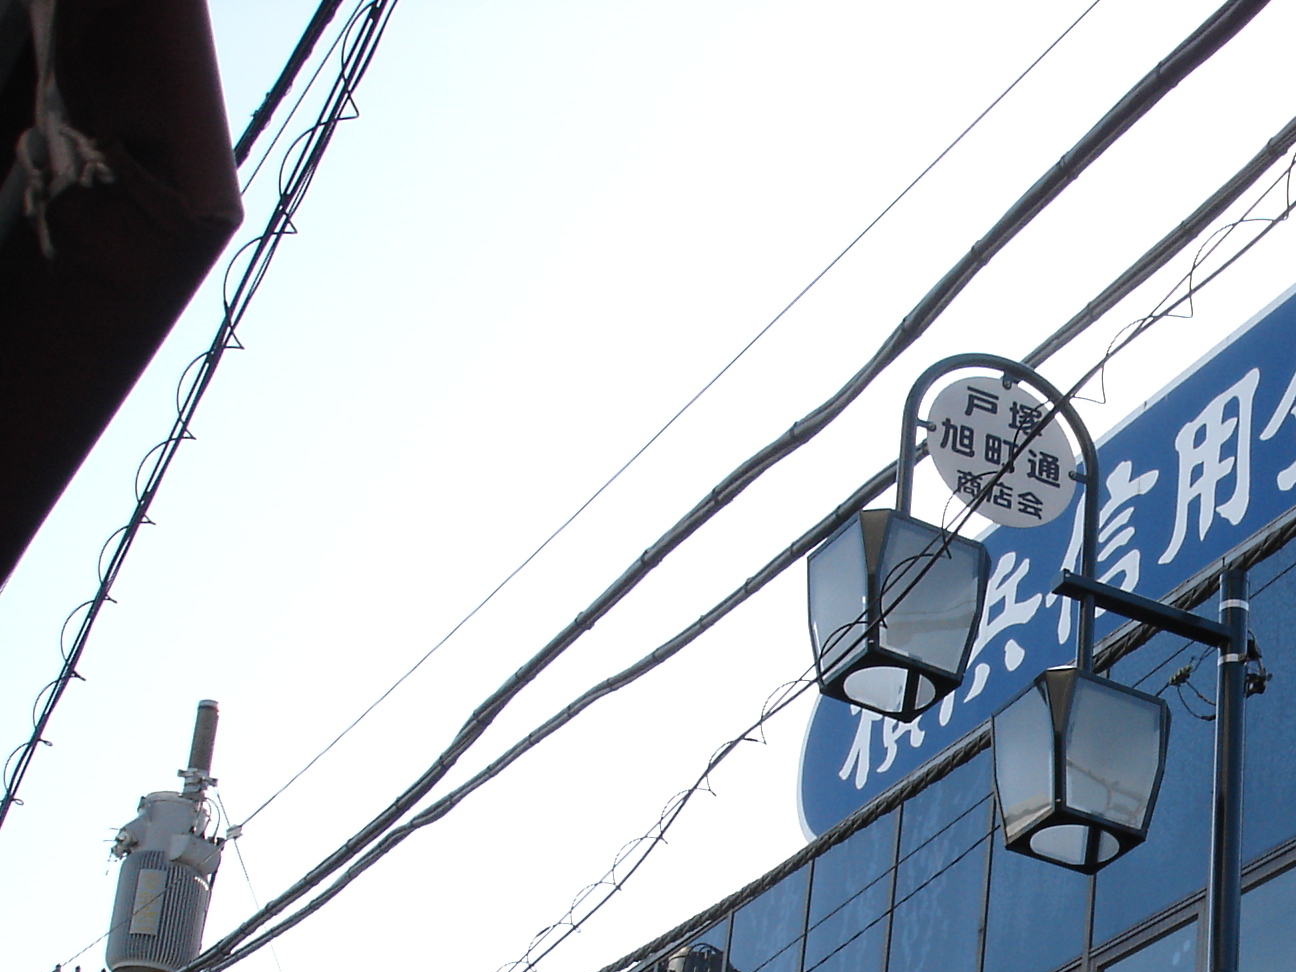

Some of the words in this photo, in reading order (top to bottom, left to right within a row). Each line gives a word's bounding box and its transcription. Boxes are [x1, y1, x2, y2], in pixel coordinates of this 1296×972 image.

[965, 386, 1043, 437] 戸塚
[940, 417, 1060, 488] 旭町通
[957, 469, 1044, 520] 商店会
